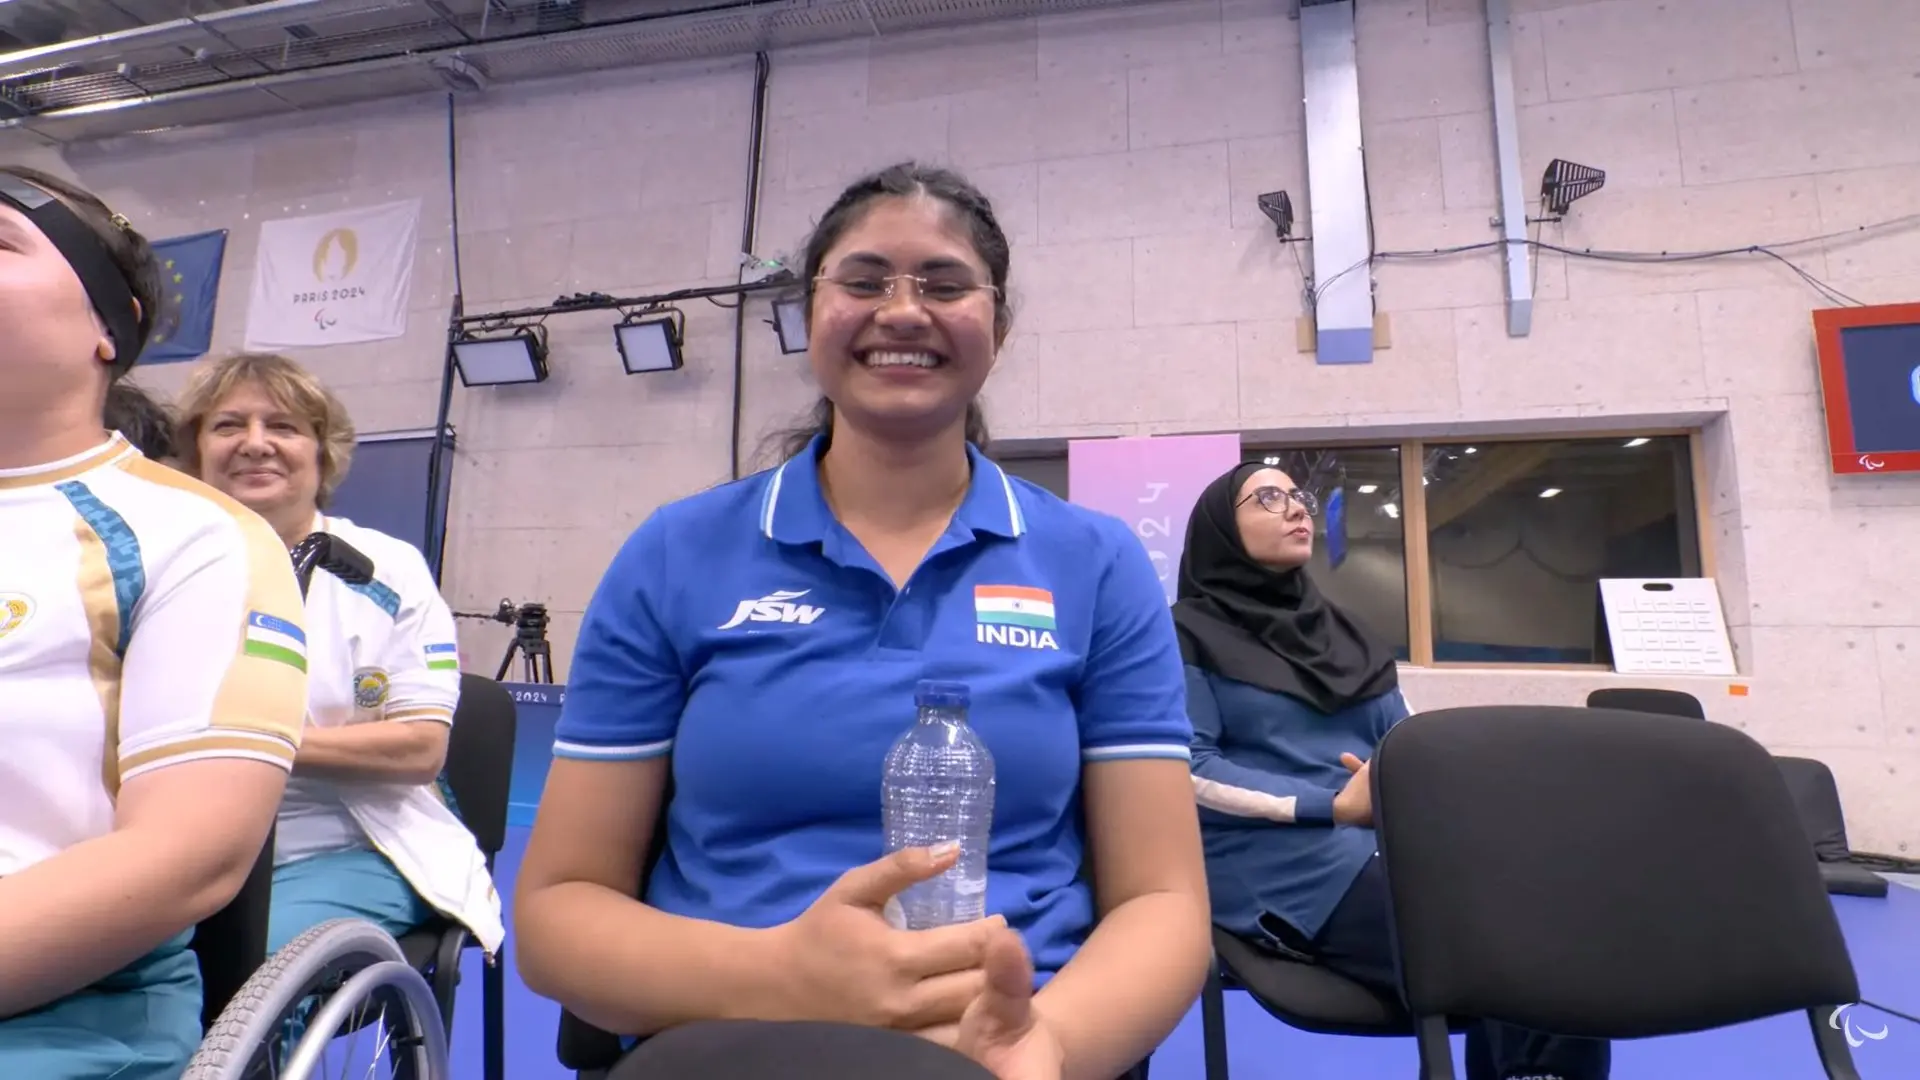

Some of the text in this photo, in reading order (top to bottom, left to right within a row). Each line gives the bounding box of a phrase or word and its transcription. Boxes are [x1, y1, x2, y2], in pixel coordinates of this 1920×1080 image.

[293, 286, 365, 303] PARIS 2024
[1138, 482, 1171, 608] 024
[717, 589, 825, 630] JSW
[976, 623, 1060, 650] INDIA
[515, 691, 548, 703] 2024
